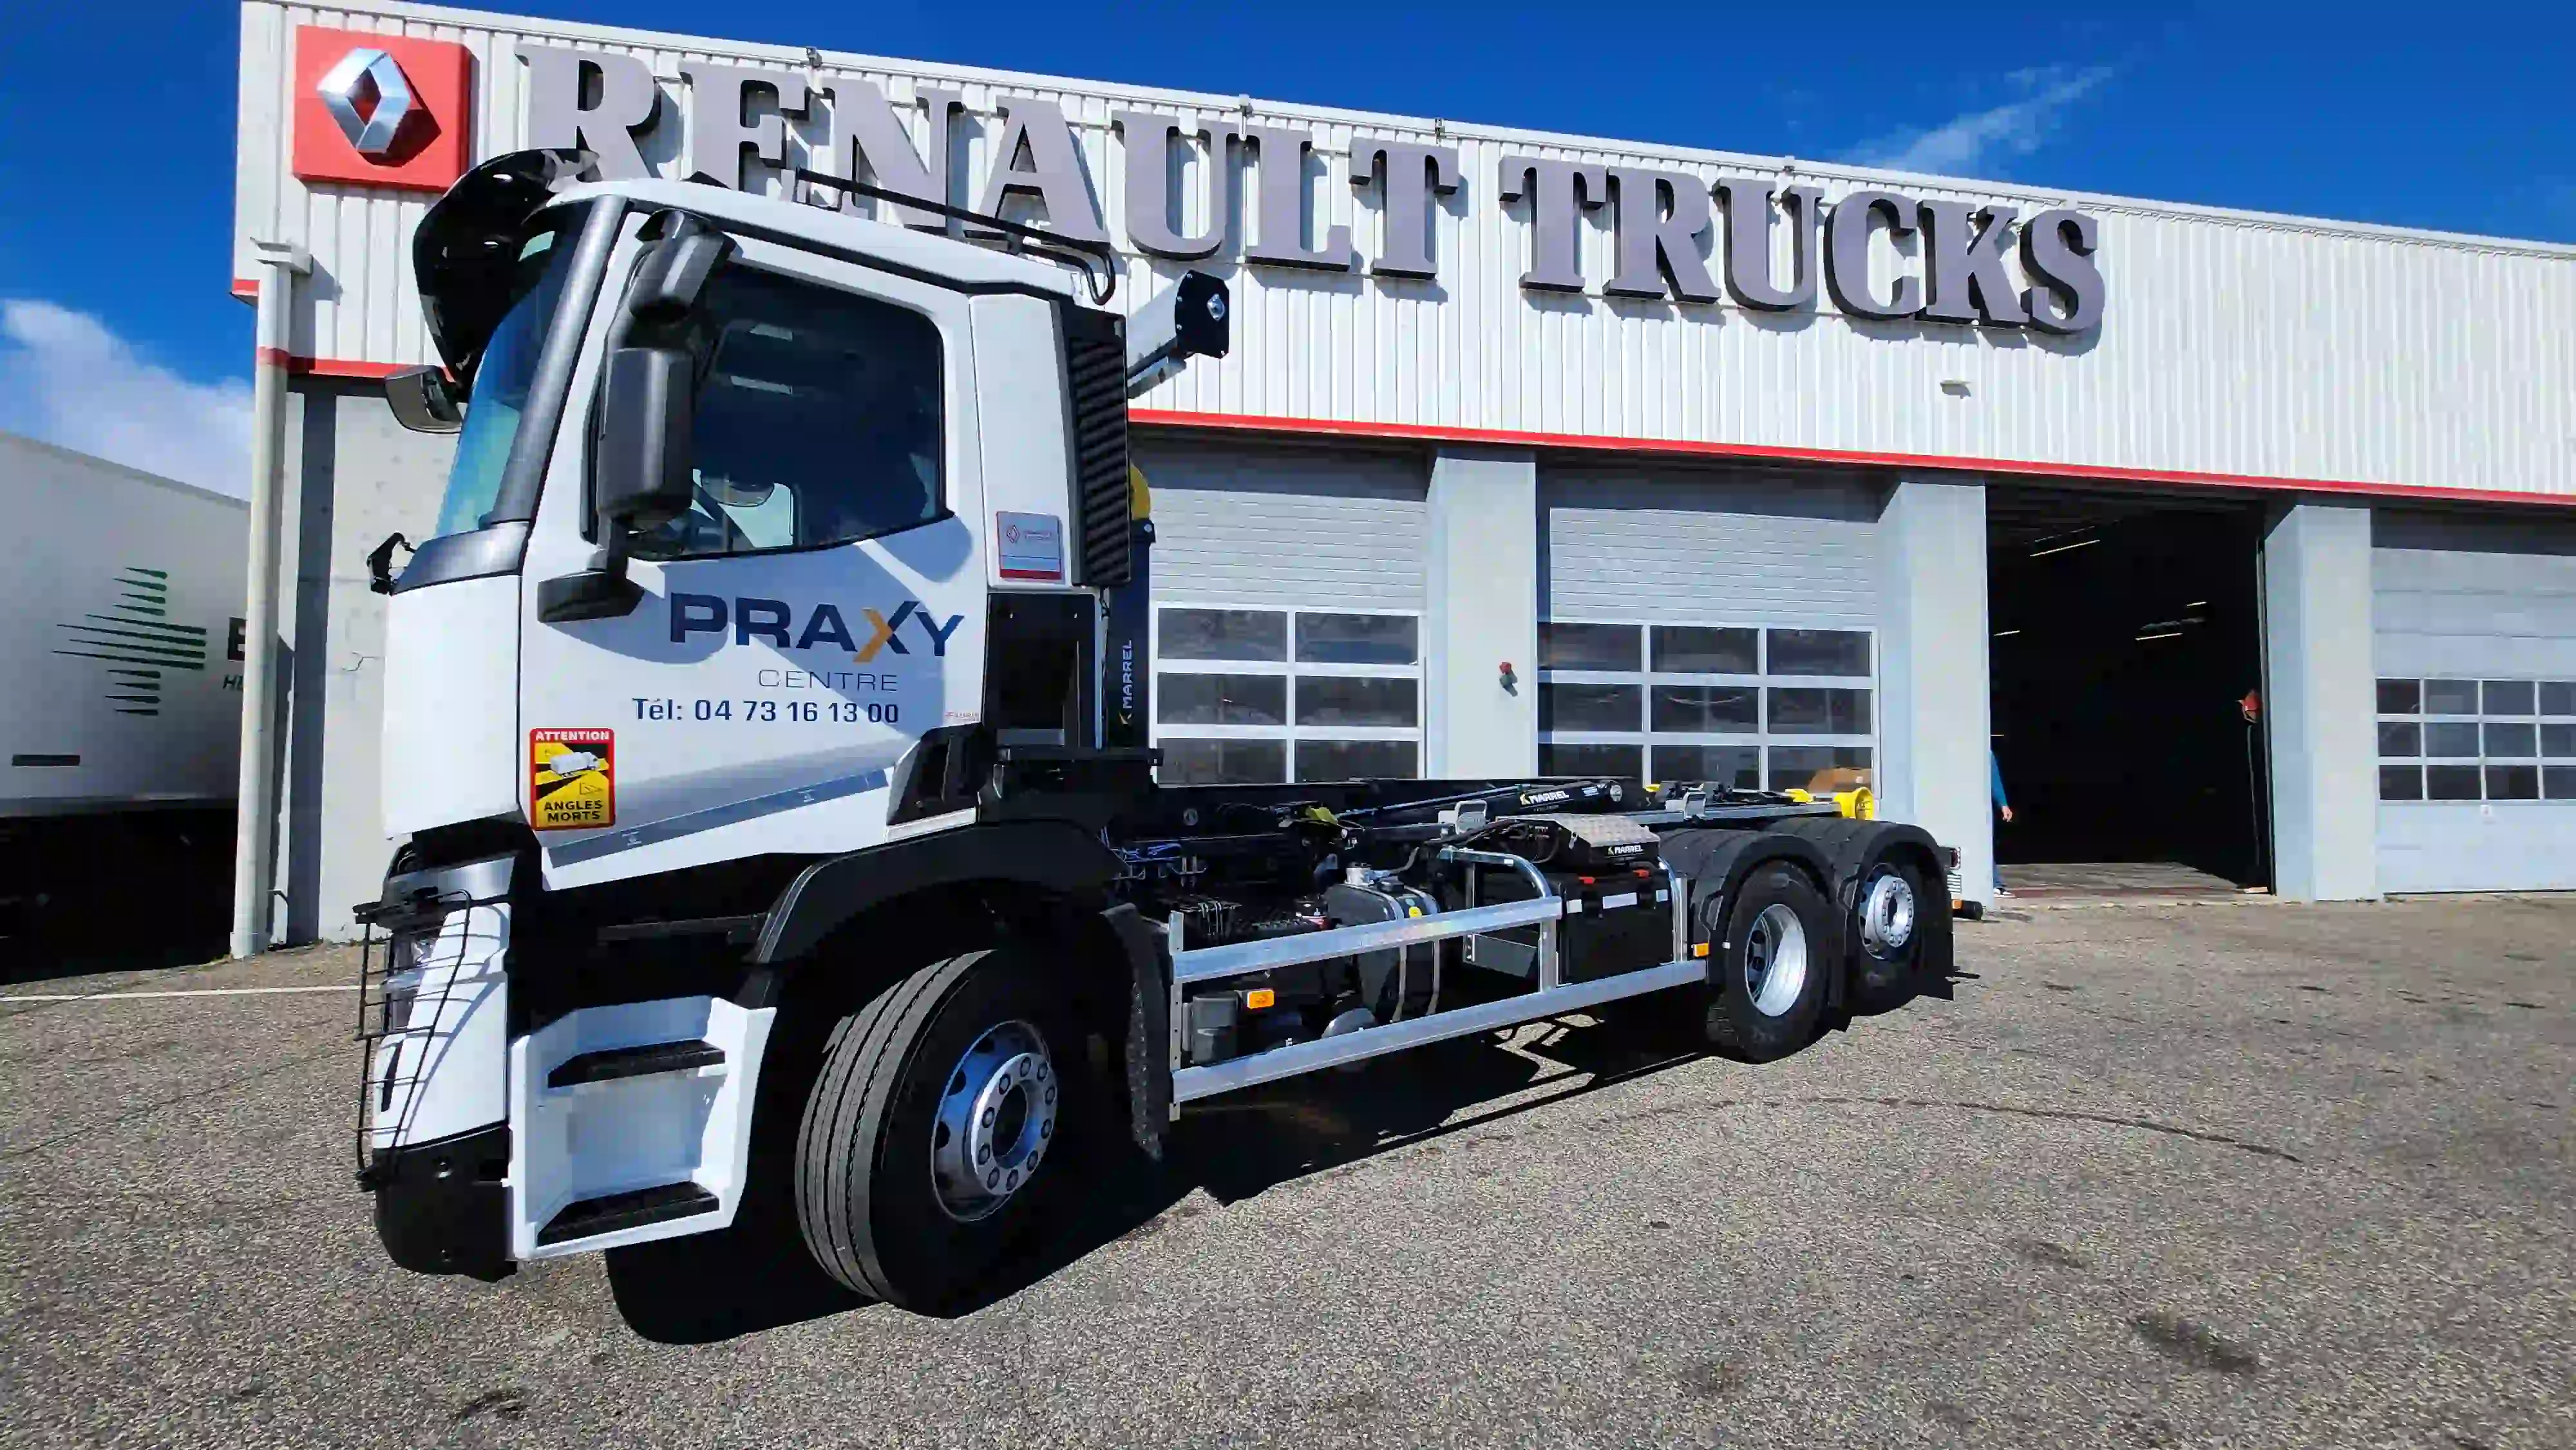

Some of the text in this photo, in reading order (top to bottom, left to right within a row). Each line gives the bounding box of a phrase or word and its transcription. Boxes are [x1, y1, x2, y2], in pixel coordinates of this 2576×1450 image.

[516, 42, 2105, 334] RENAULT TRUCKS
[670, 592, 965, 663] PRAXY
[758, 669, 898, 692] CENTRE
[1122, 639, 1133, 709] MARREL
[632, 697, 899, 723] Tél: 04 73 16 13 00
[535, 731, 609, 740] ATTENTION
[544, 800, 603, 811] ANGLES
[1528, 790, 1569, 804] MARREL
[547, 811, 601, 822] MORTS
[1615, 844, 1643, 855] MARREL
